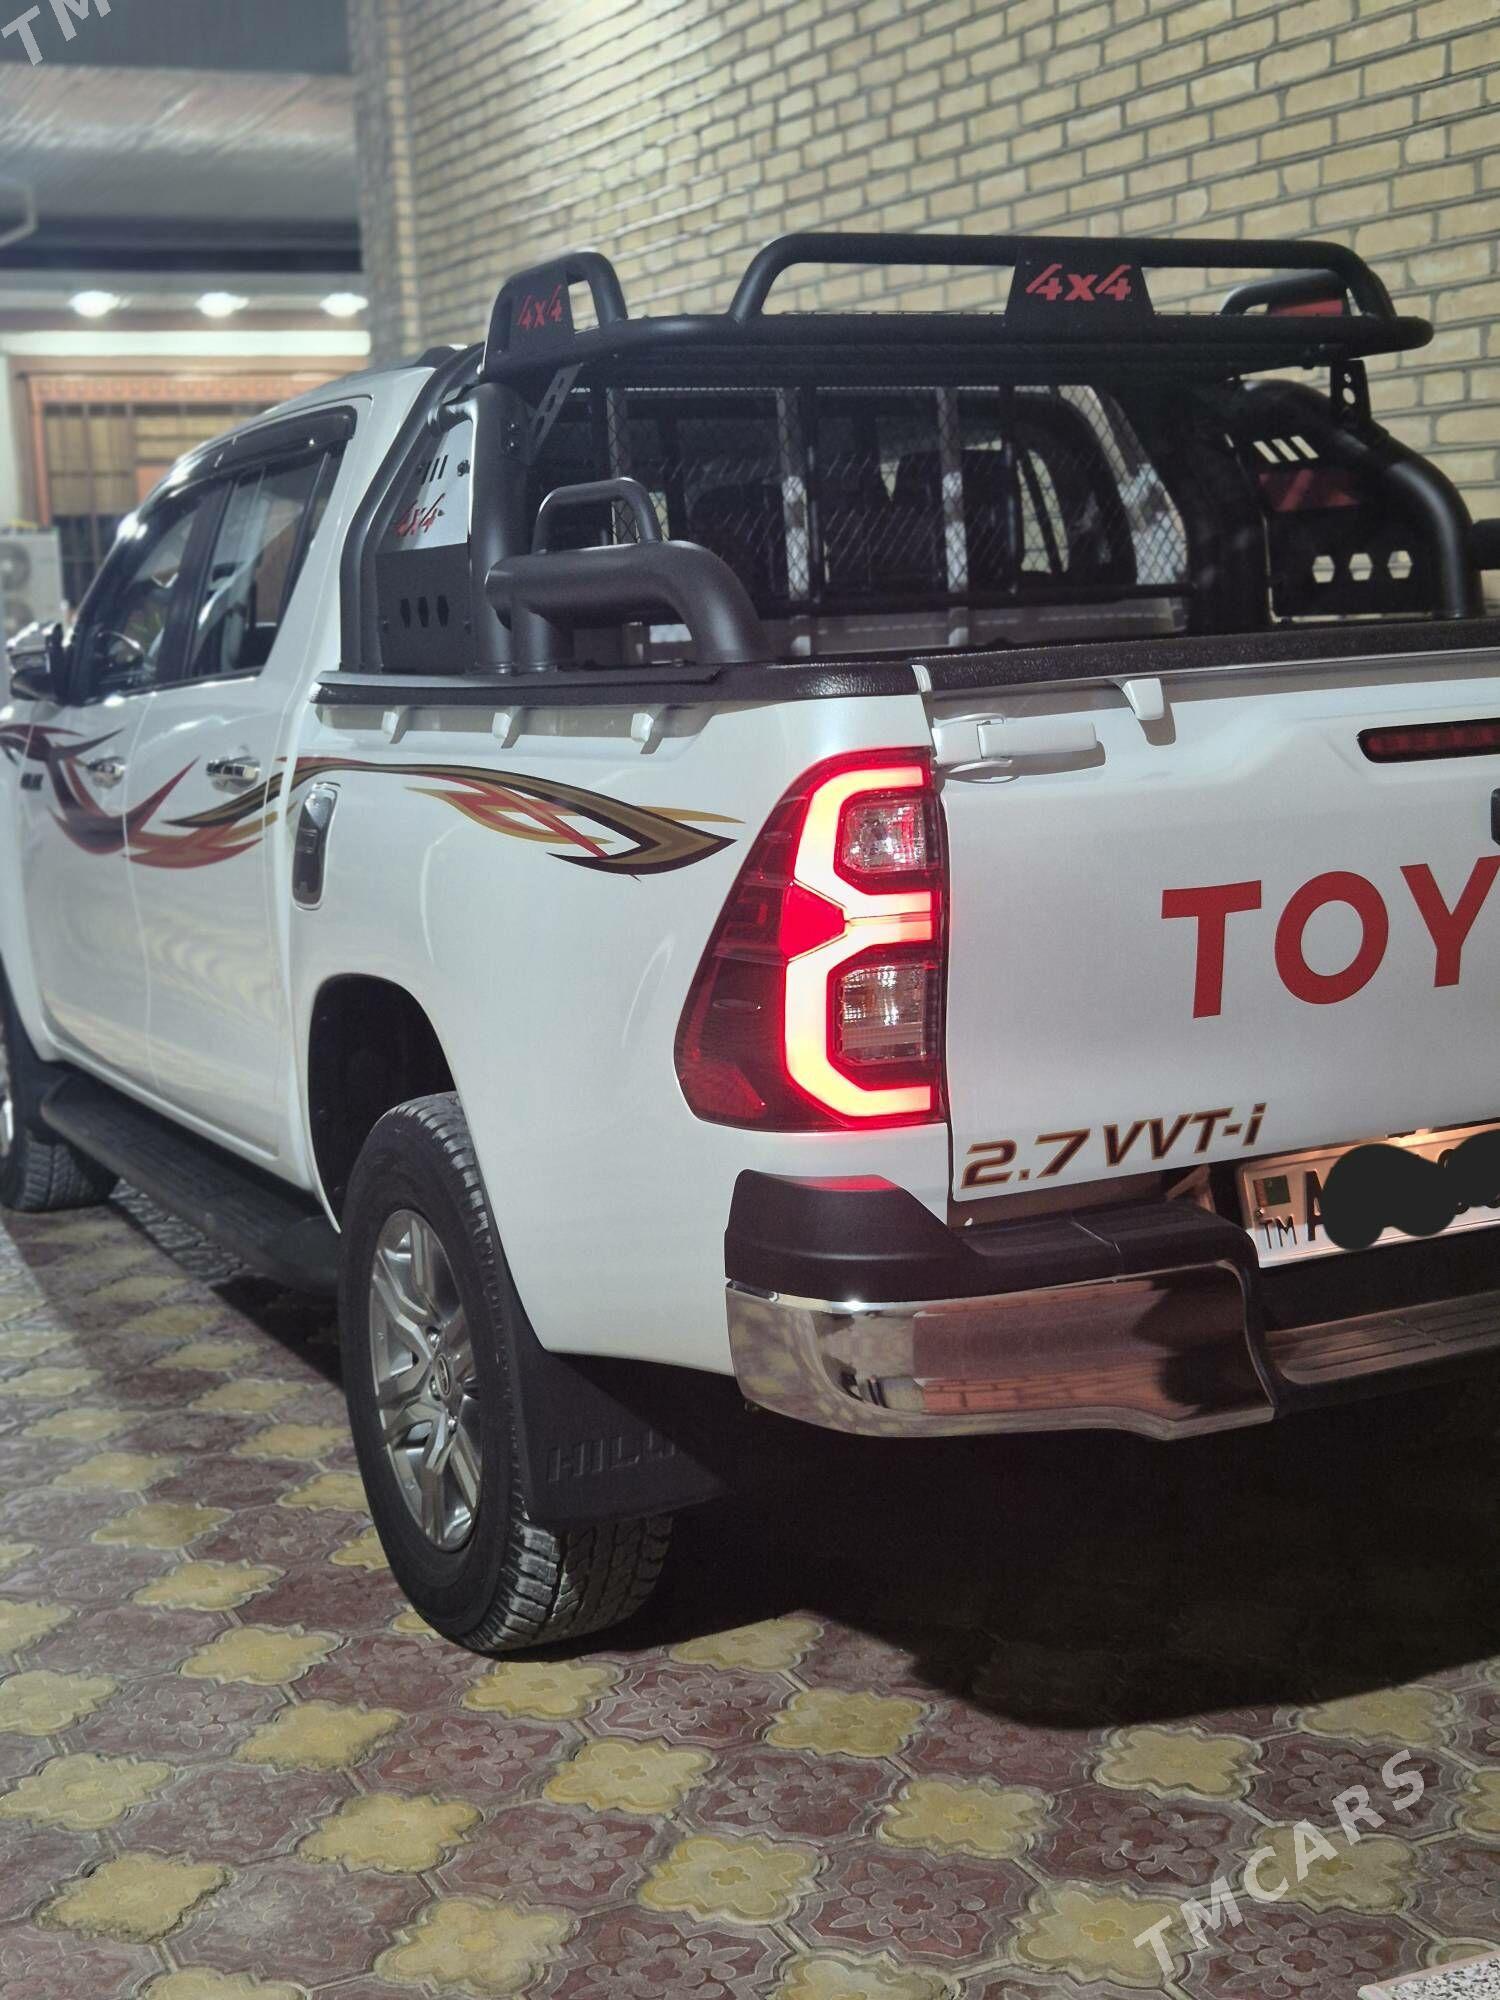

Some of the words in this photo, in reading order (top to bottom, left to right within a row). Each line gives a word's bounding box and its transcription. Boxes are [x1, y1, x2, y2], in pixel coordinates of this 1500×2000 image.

[1161, 854, 1500, 1020] TOY
[960, 1127, 1092, 1190] 2.7
[1103, 1102, 1267, 1169] VVT-i
[1259, 1213, 1298, 1250] TM
